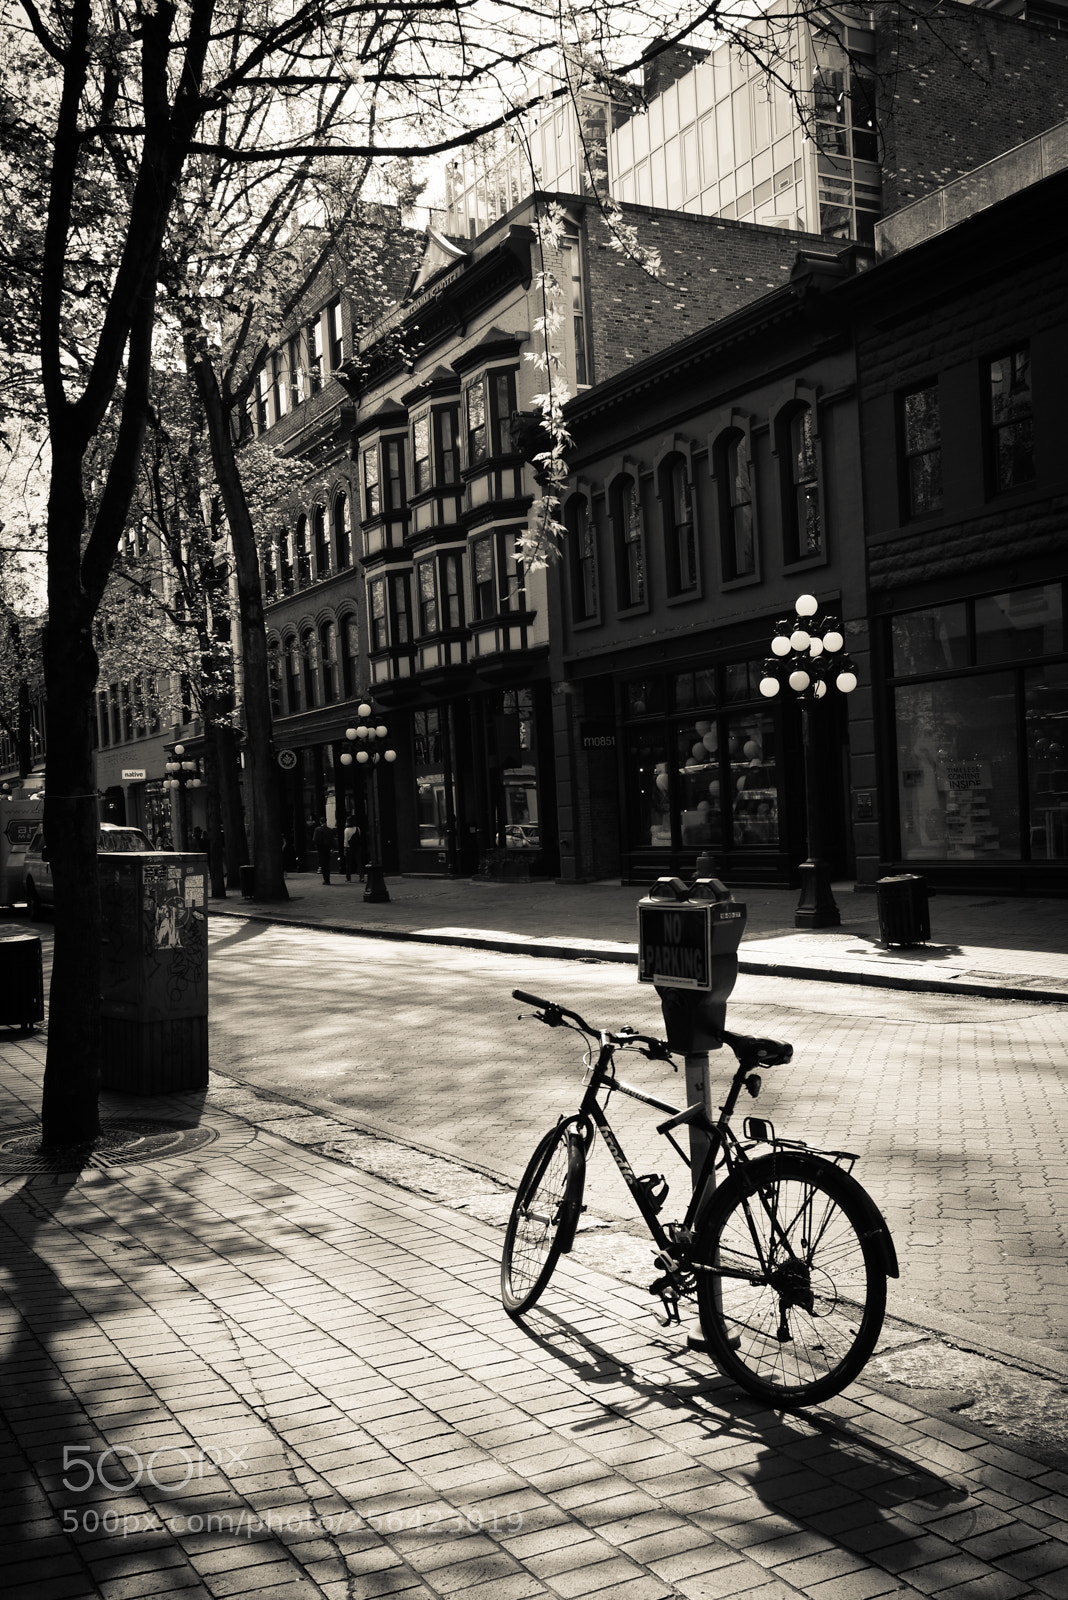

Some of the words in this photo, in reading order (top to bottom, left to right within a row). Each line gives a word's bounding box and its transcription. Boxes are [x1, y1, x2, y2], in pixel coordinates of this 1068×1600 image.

[583, 736, 615, 747] m0851
[949, 780, 981, 789] INSIDE
[663, 912, 682, 944] NO
[646, 945, 703, 979] PARKING
